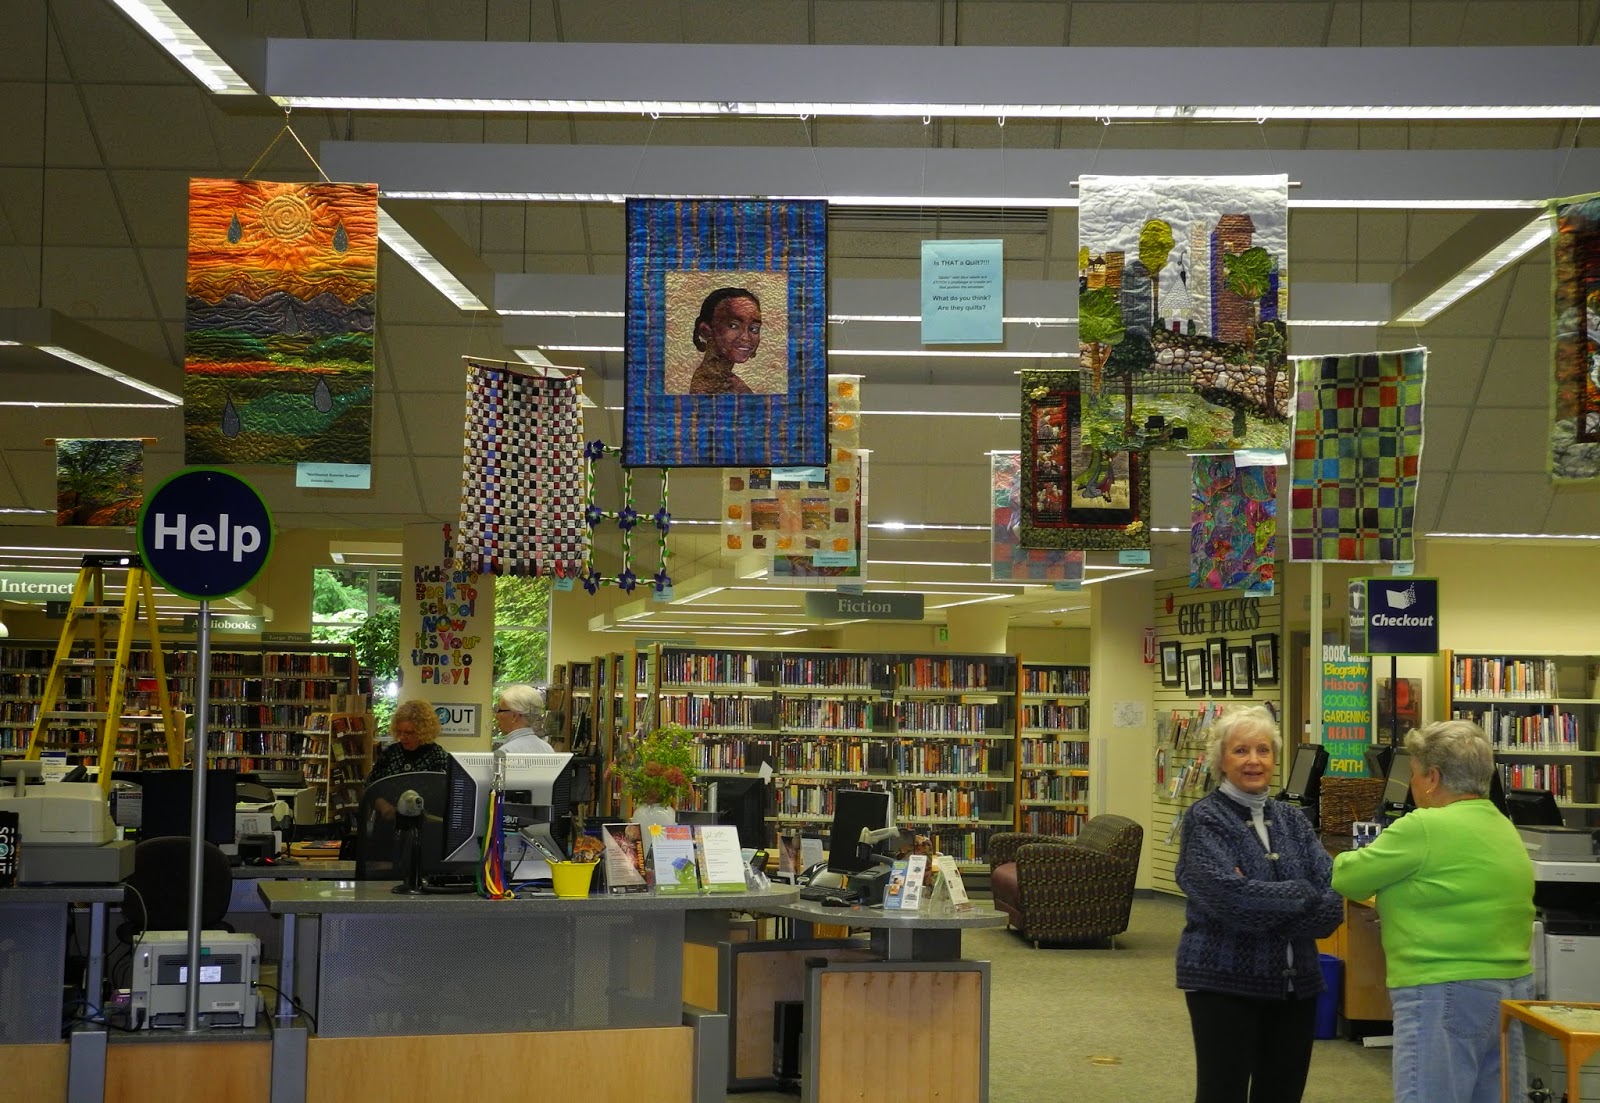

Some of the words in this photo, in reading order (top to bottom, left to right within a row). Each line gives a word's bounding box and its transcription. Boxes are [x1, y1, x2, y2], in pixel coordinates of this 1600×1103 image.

[965, 304, 986, 312] quilts?
[155, 513, 261, 562] Help
[453, 571, 478, 584] are
[1, 579, 75, 594] Internet
[416, 582, 457, 600] Back
[420, 597, 475, 617] school
[837, 598, 892, 613] Fiction
[1178, 602, 1205, 635] GIG
[1210, 597, 1260, 634] PICKS
[1371, 613, 1434, 626] Checkout
[192, 619, 257, 630] Aiobooks
[415, 632, 438, 649] it's
[411, 649, 450, 666] time
[452, 649, 472, 667] to
[1322, 645, 1346, 662] BOOK
[421, 666, 470, 685] Play!
[1324, 663, 1369, 679] Biography
[1324, 678, 1368, 694] History
[1324, 694, 1368, 707] COOKING
[1323, 710, 1370, 723] GARDENING
[1328, 727, 1366, 739] HEALTH
[1330, 759, 1364, 773] FAITH
